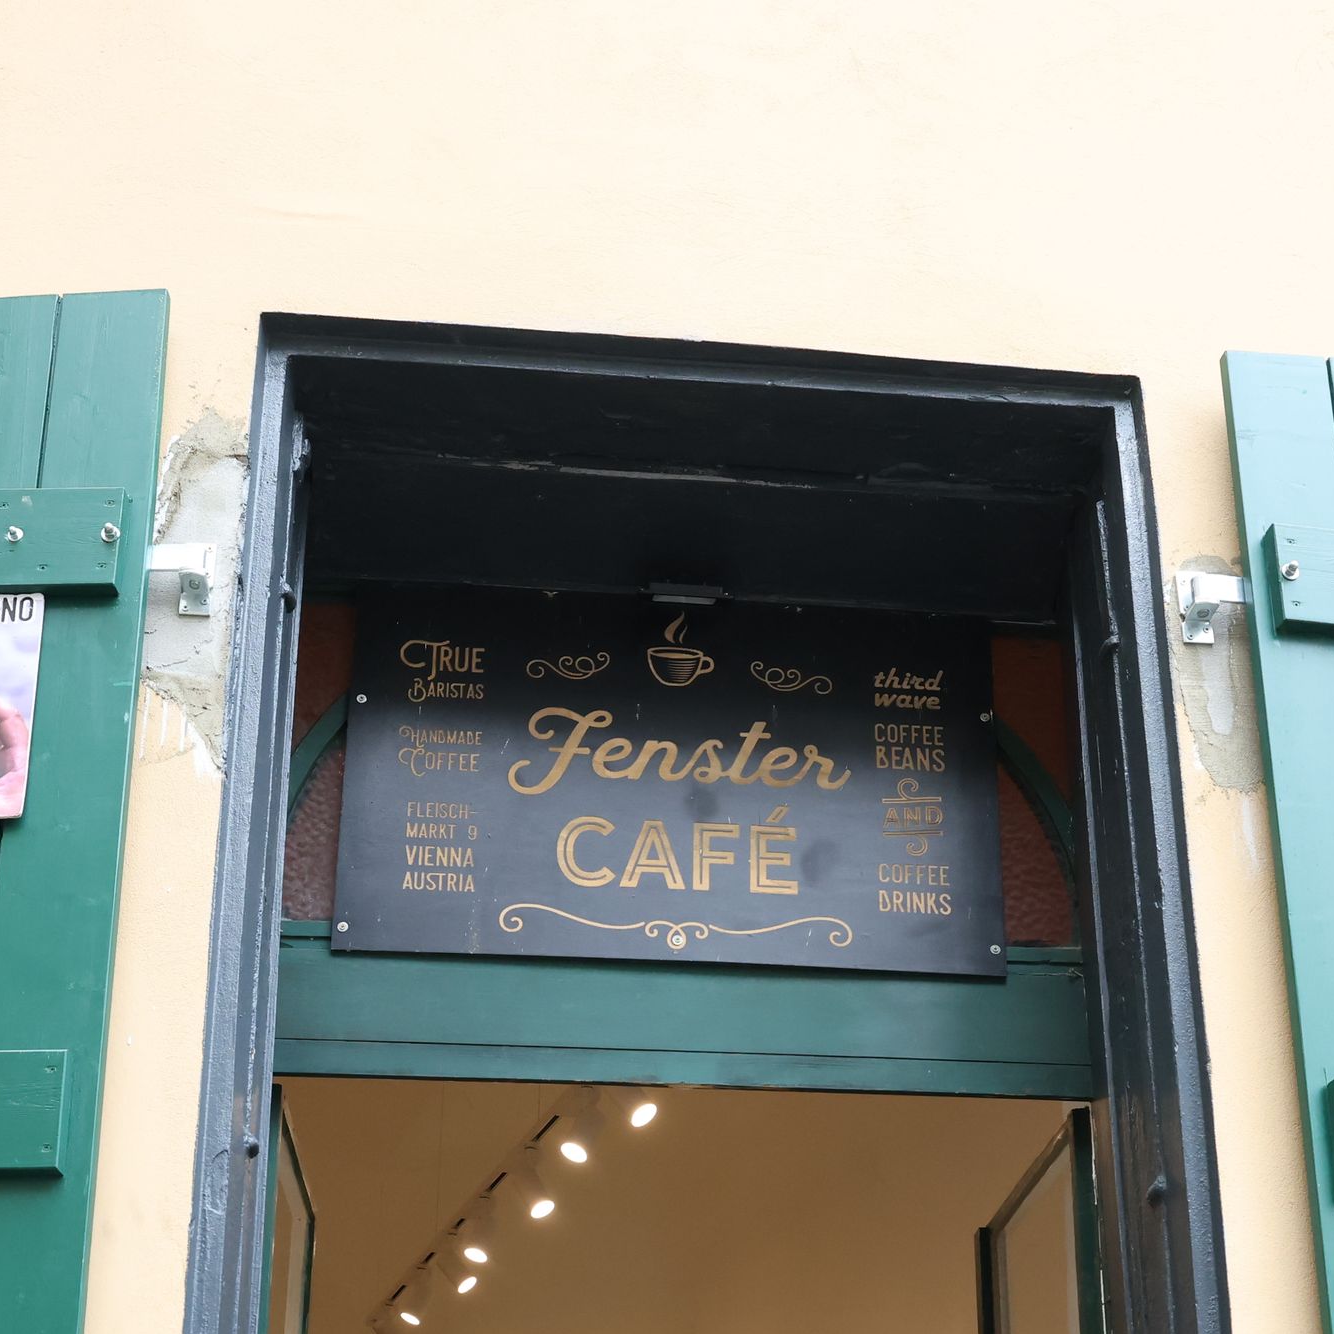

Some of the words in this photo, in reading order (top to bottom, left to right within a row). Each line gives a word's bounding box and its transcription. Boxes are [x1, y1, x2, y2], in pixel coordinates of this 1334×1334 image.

[400, 639, 485, 674] TRUE
[408, 678, 484, 702] BARISTAS
[874, 667, 943, 692] third
[874, 692, 941, 710] wave
[399, 724, 483, 747] HANDMADE
[874, 722, 944, 747] COFFEE
[399, 746, 479, 777] COFFEE
[508, 706, 852, 796] Fenster
[875, 748, 946, 773] BEANS
[405, 801, 477, 820] FLEISCH-
[882, 805, 943, 828] AND
[405, 822, 456, 841] MARKT
[467, 824, 478, 842] 9
[405, 845, 475, 868] VIENNA
[556, 806, 799, 895] CAFÉ
[402, 870, 475, 893] AUSTRIA
[878, 862, 950, 887] COFFEE
[878, 890, 952, 915] DRINKS
